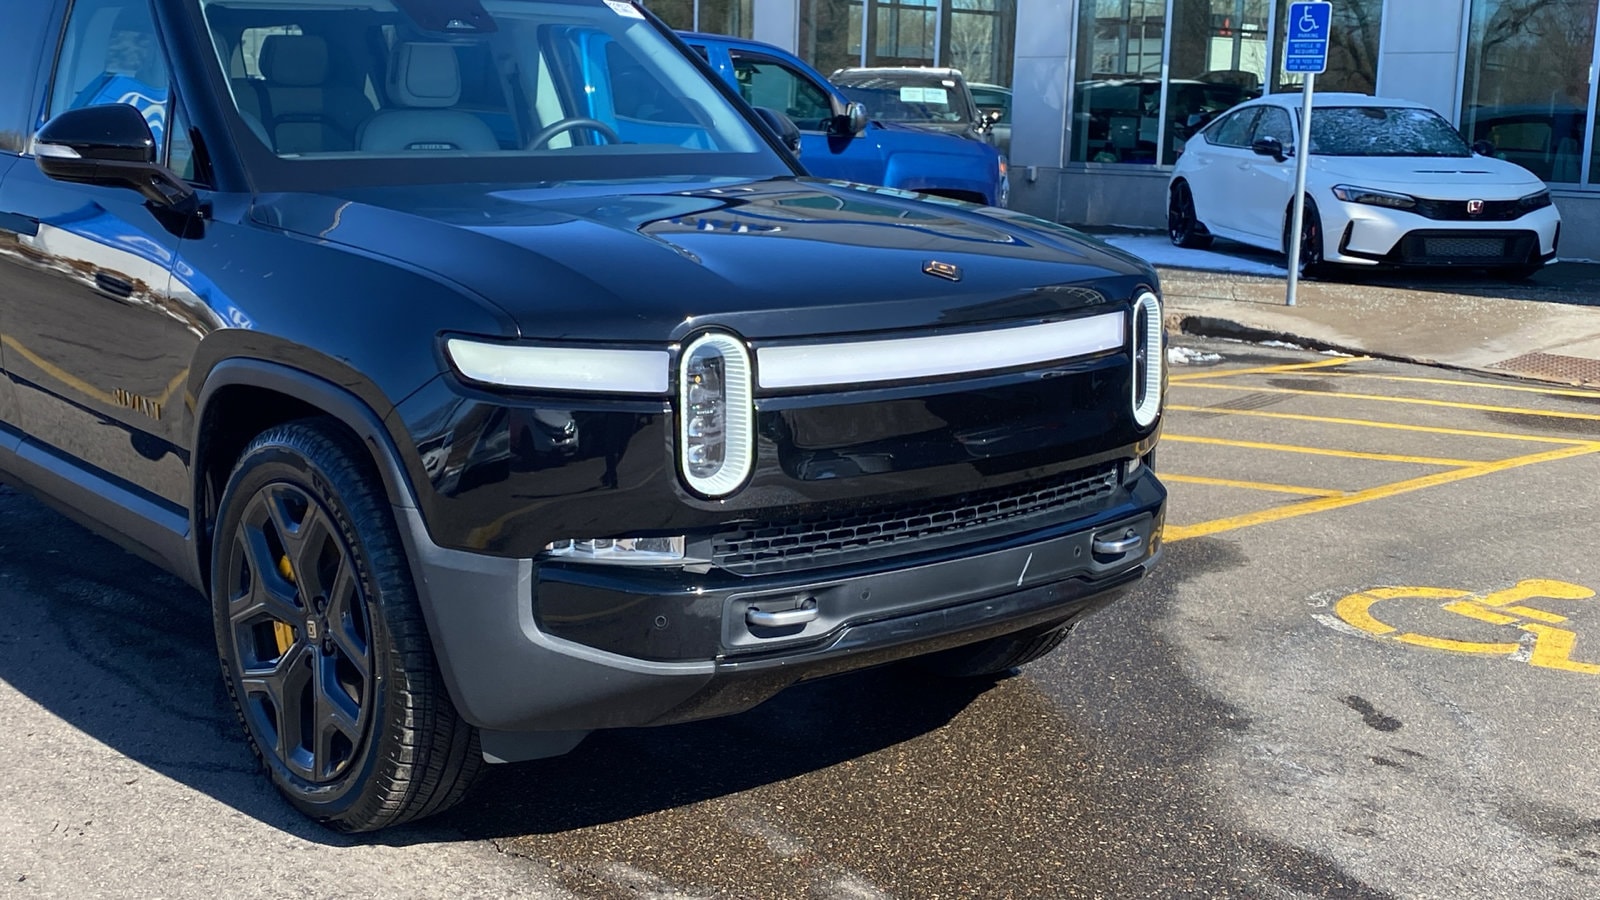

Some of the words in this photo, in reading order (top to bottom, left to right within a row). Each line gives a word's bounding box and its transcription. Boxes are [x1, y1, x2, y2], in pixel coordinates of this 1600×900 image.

[112, 387, 162, 421] RIVIAN
[327, 496, 372, 598] MICHELIN
[222, 663, 261, 758] MICHELIN
